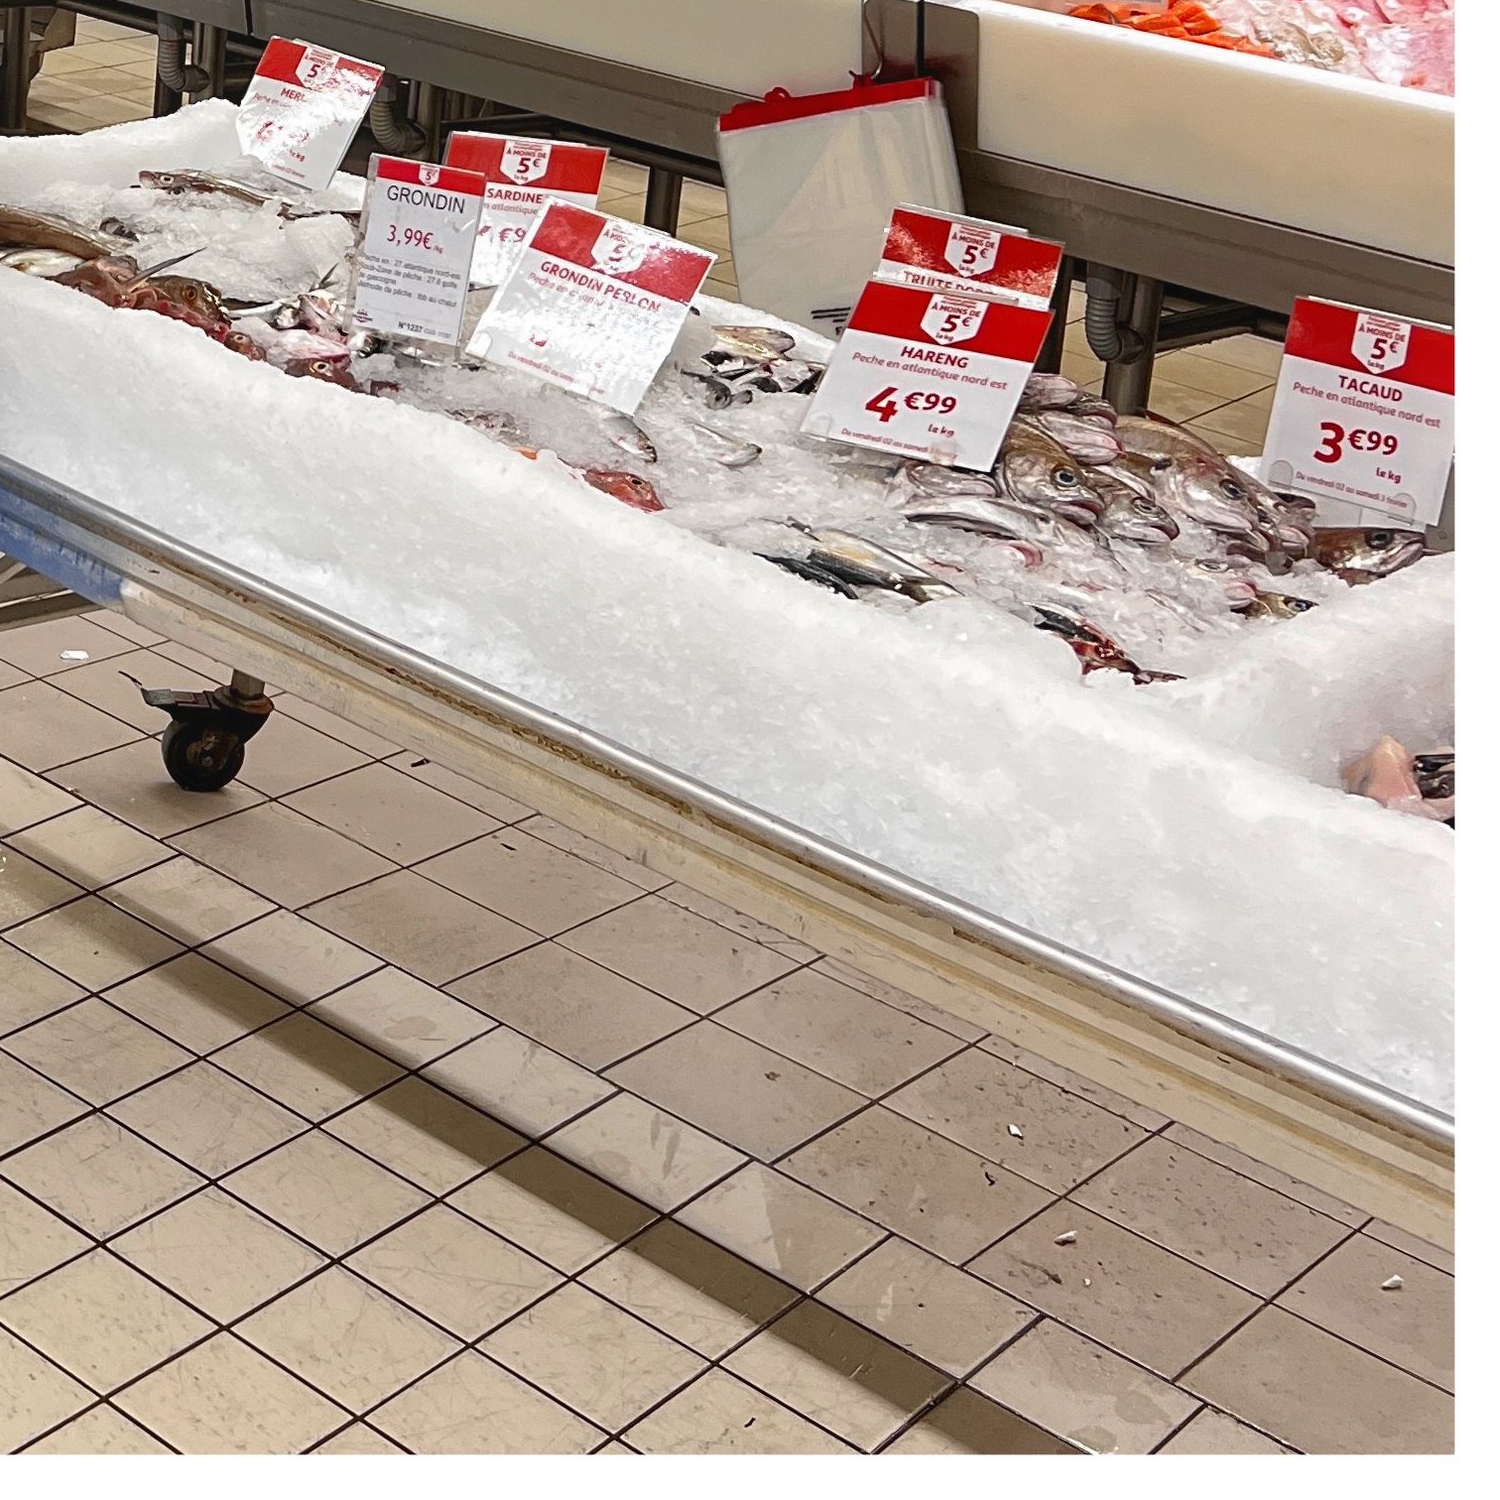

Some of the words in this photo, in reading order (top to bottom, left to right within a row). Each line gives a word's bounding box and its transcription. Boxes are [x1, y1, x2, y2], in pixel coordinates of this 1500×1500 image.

[516, 157, 541, 174] 5€
[387, 185, 465, 214] GRONDIN
[487, 188, 544, 204] SARDINE
[387, 224, 435, 250] 3,99€
[958, 235, 984, 247] MOINS
[962, 245, 989, 265] 5€
[541, 261, 604, 292] GRONDIN
[939, 304, 967, 317] MOINS
[968, 308, 981, 318] DE
[940, 314, 971, 333] 5€
[1366, 326, 1393, 340] MOINS
[900, 345, 968, 369] HARENG
[1370, 338, 1398, 360] 5€
[852, 351, 884, 368] Peche
[886, 359, 900, 369] en
[901, 361, 958, 381] atlantique
[960, 370, 988, 388] nord
[989, 378, 1008, 391] est
[1338, 375, 1404, 402] TACAUD
[865, 386, 957, 423] 4€99
[1293, 381, 1324, 399] Peche
[1326, 391, 1339, 401] en
[1341, 394, 1396, 418] atlantique
[1398, 406, 1423, 424] nord
[1425, 416, 1441, 429] est
[1313, 421, 1398, 464] 3€99
[1376, 466, 1387, 478] Le
[1388, 467, 1402, 485] kg
